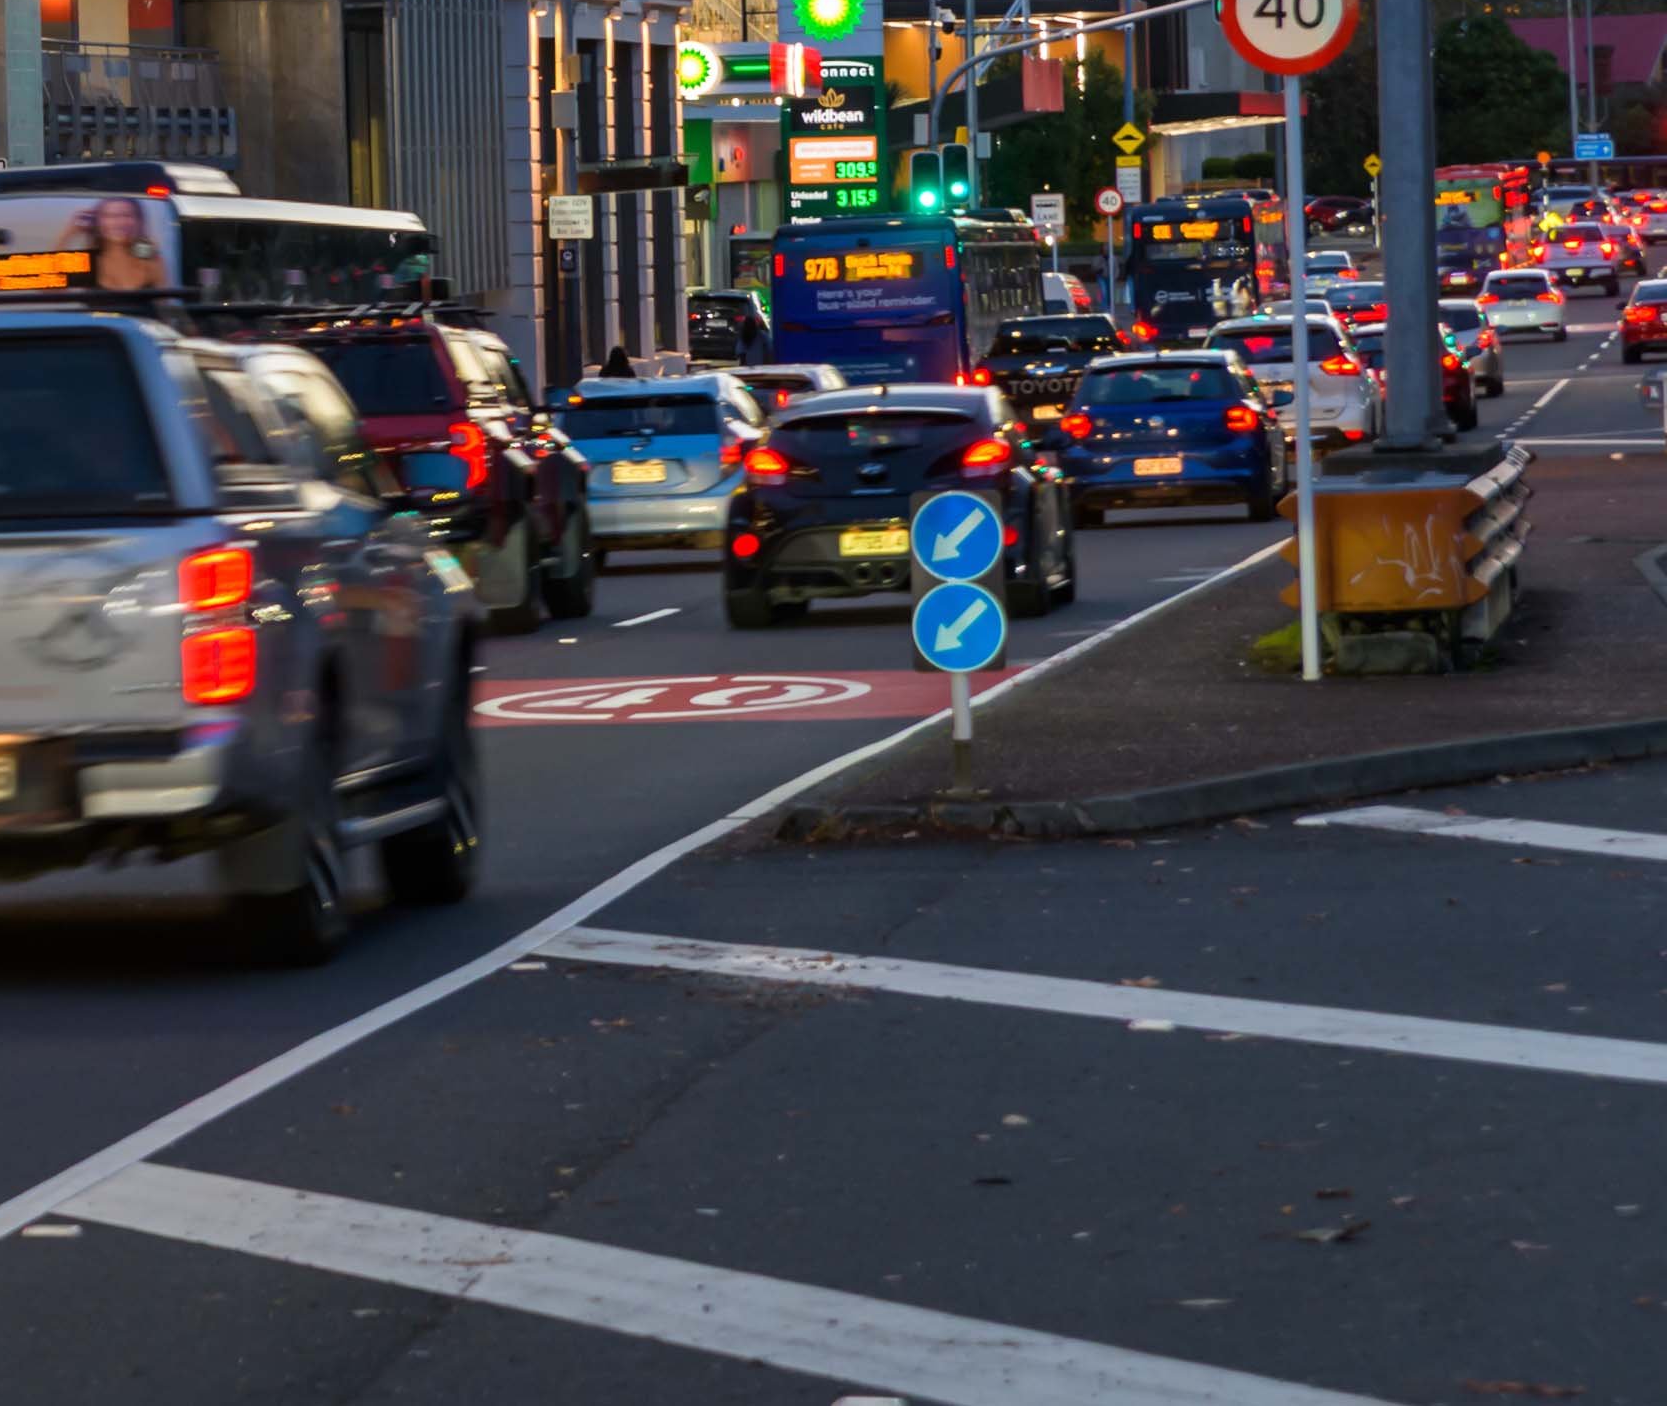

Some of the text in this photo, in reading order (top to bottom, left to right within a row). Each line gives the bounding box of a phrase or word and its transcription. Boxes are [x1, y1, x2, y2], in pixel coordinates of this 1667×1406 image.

[819, 61, 875, 78] onnect
[1102, 196, 1118, 206] 40
[522, 684, 826, 709] 40
